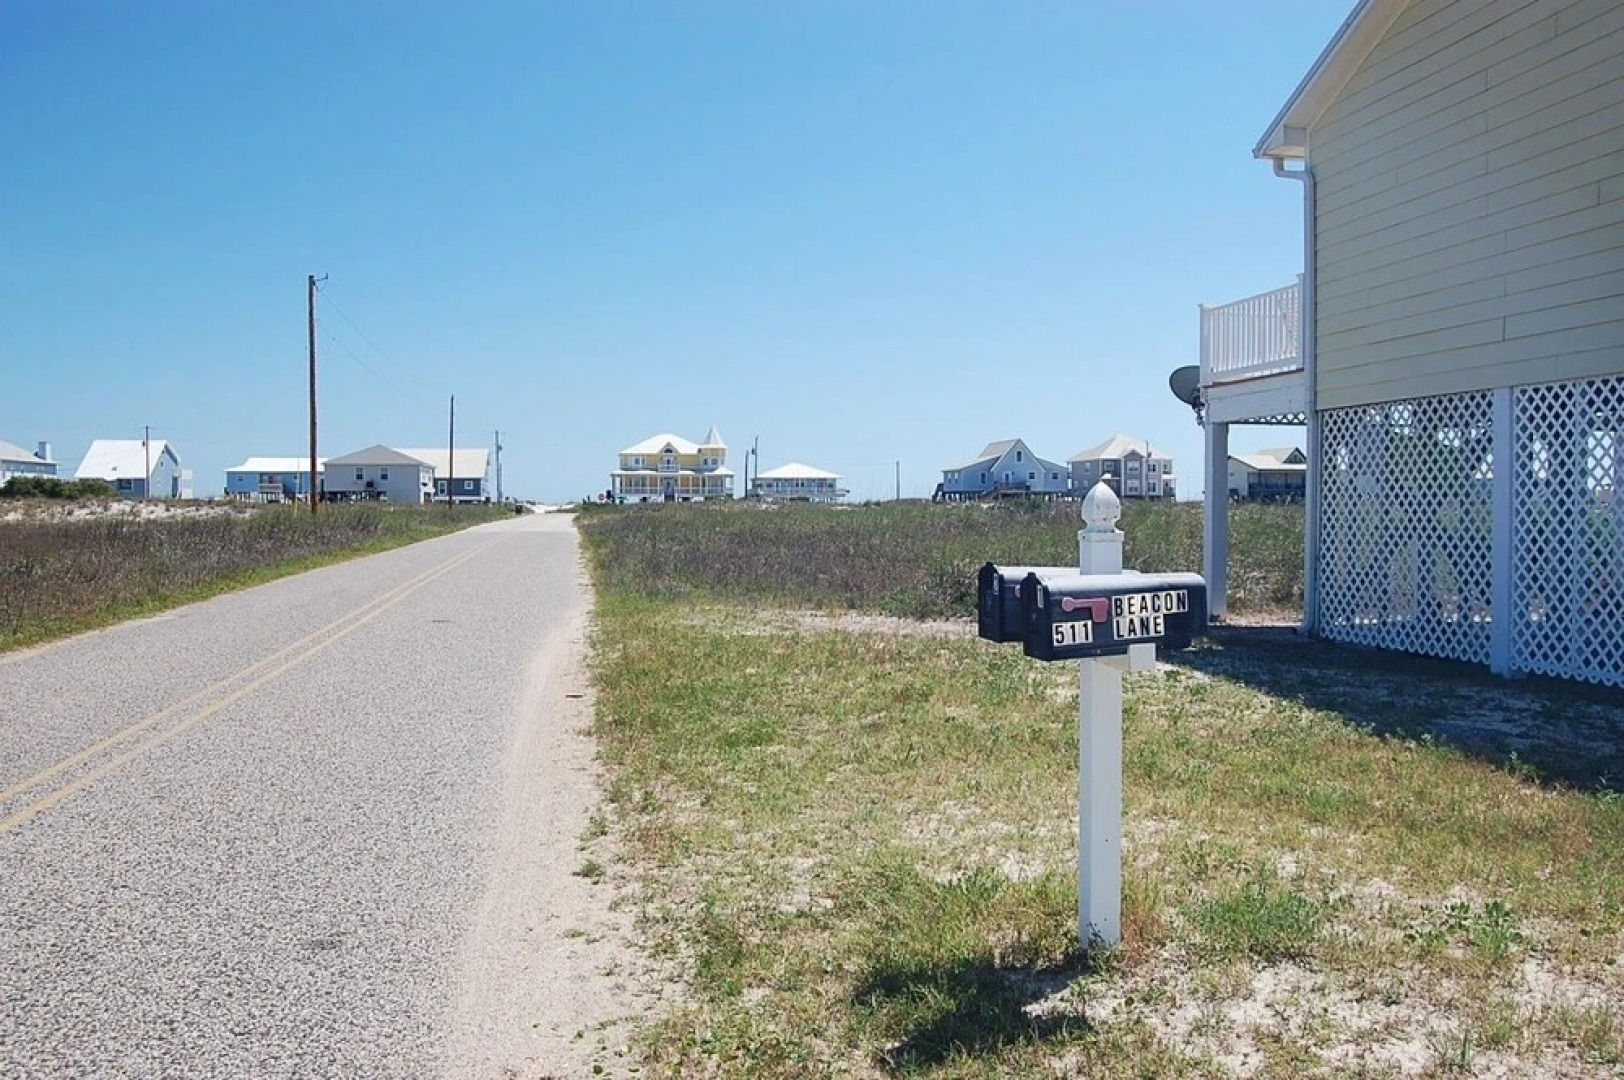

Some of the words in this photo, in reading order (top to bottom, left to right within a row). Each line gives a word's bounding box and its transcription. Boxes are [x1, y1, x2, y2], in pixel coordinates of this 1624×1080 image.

[1114, 591, 1186, 616] BEACON
[1055, 623, 1089, 643] 511
[1116, 615, 1162, 638] LANE
